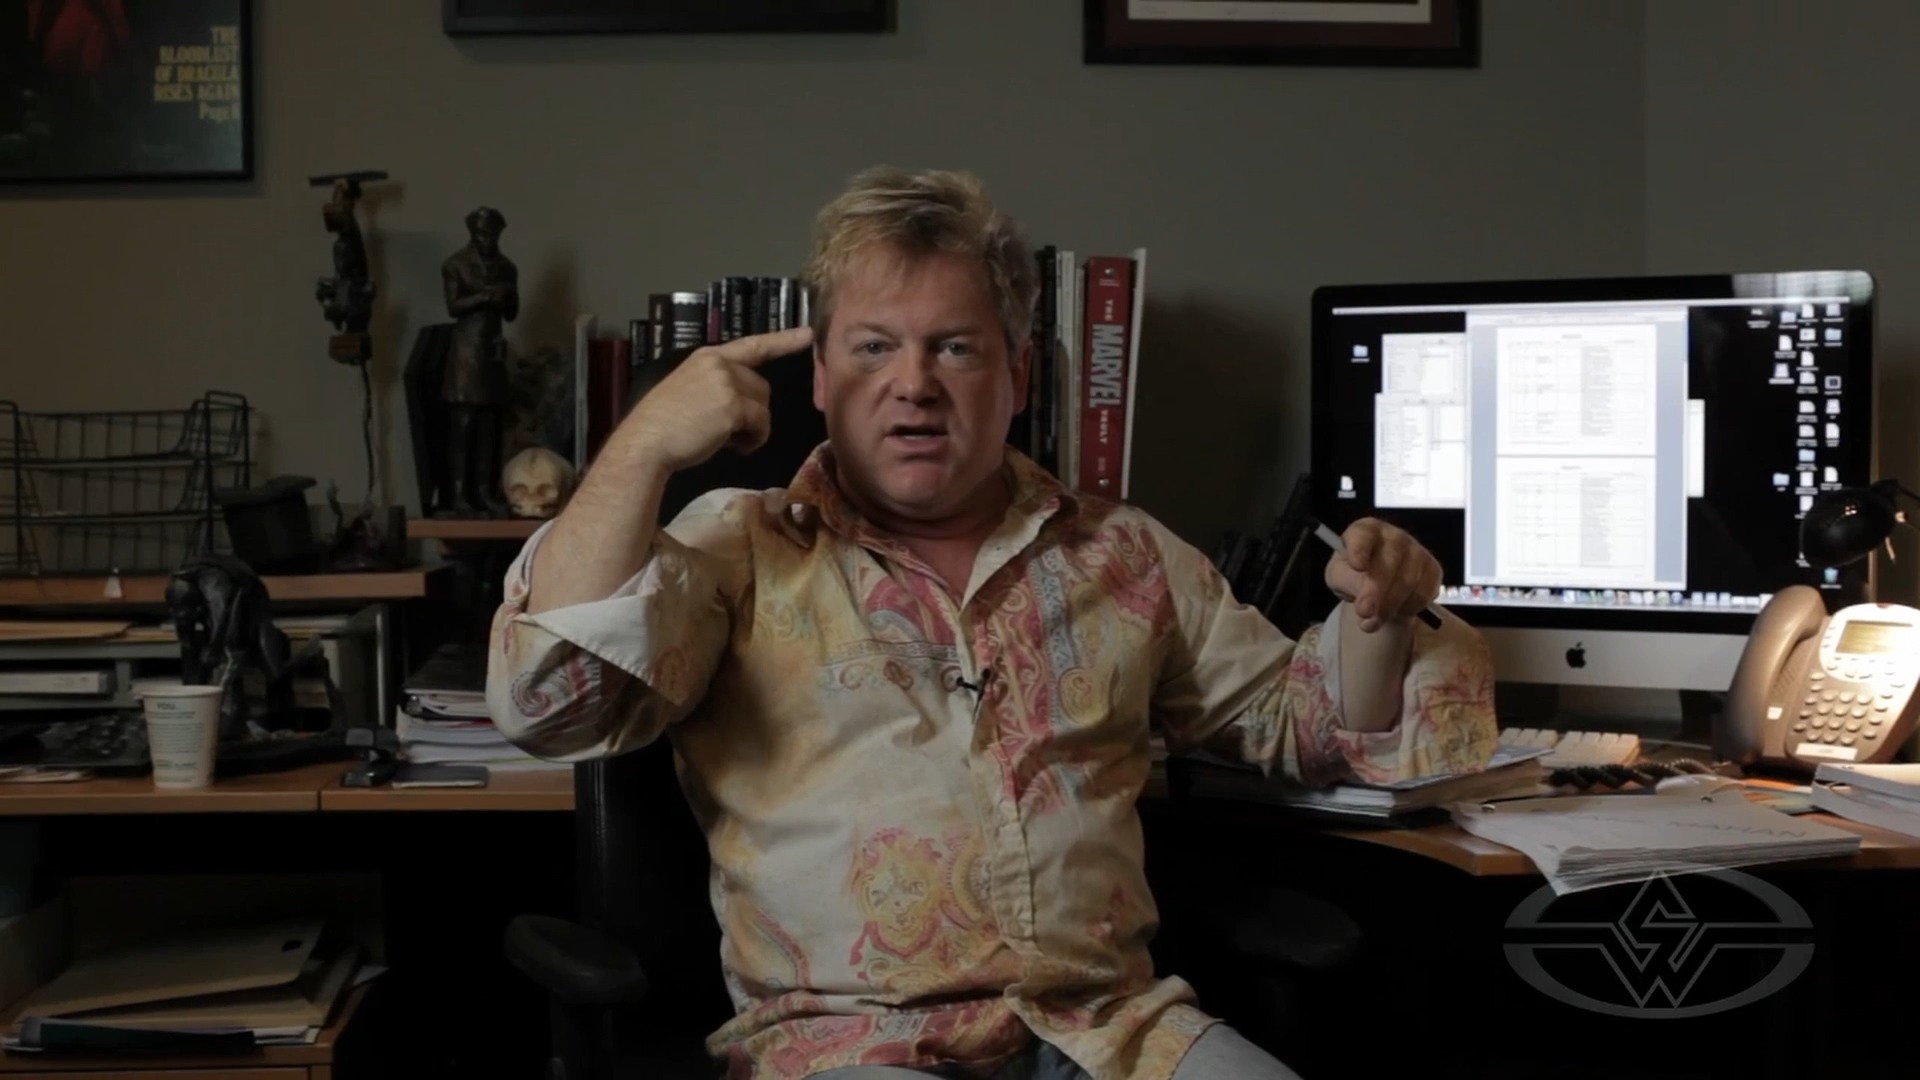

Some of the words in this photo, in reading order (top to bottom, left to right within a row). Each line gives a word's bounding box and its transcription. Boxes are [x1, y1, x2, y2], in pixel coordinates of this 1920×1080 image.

[210, 26, 239, 44] THE
[155, 64, 173, 82] OF
[177, 64, 240, 82] DRACULA
[1105, 299, 1114, 321] THE
[1089, 324, 1124, 408] MARVEL
[1099, 409, 1109, 444] VAULT
